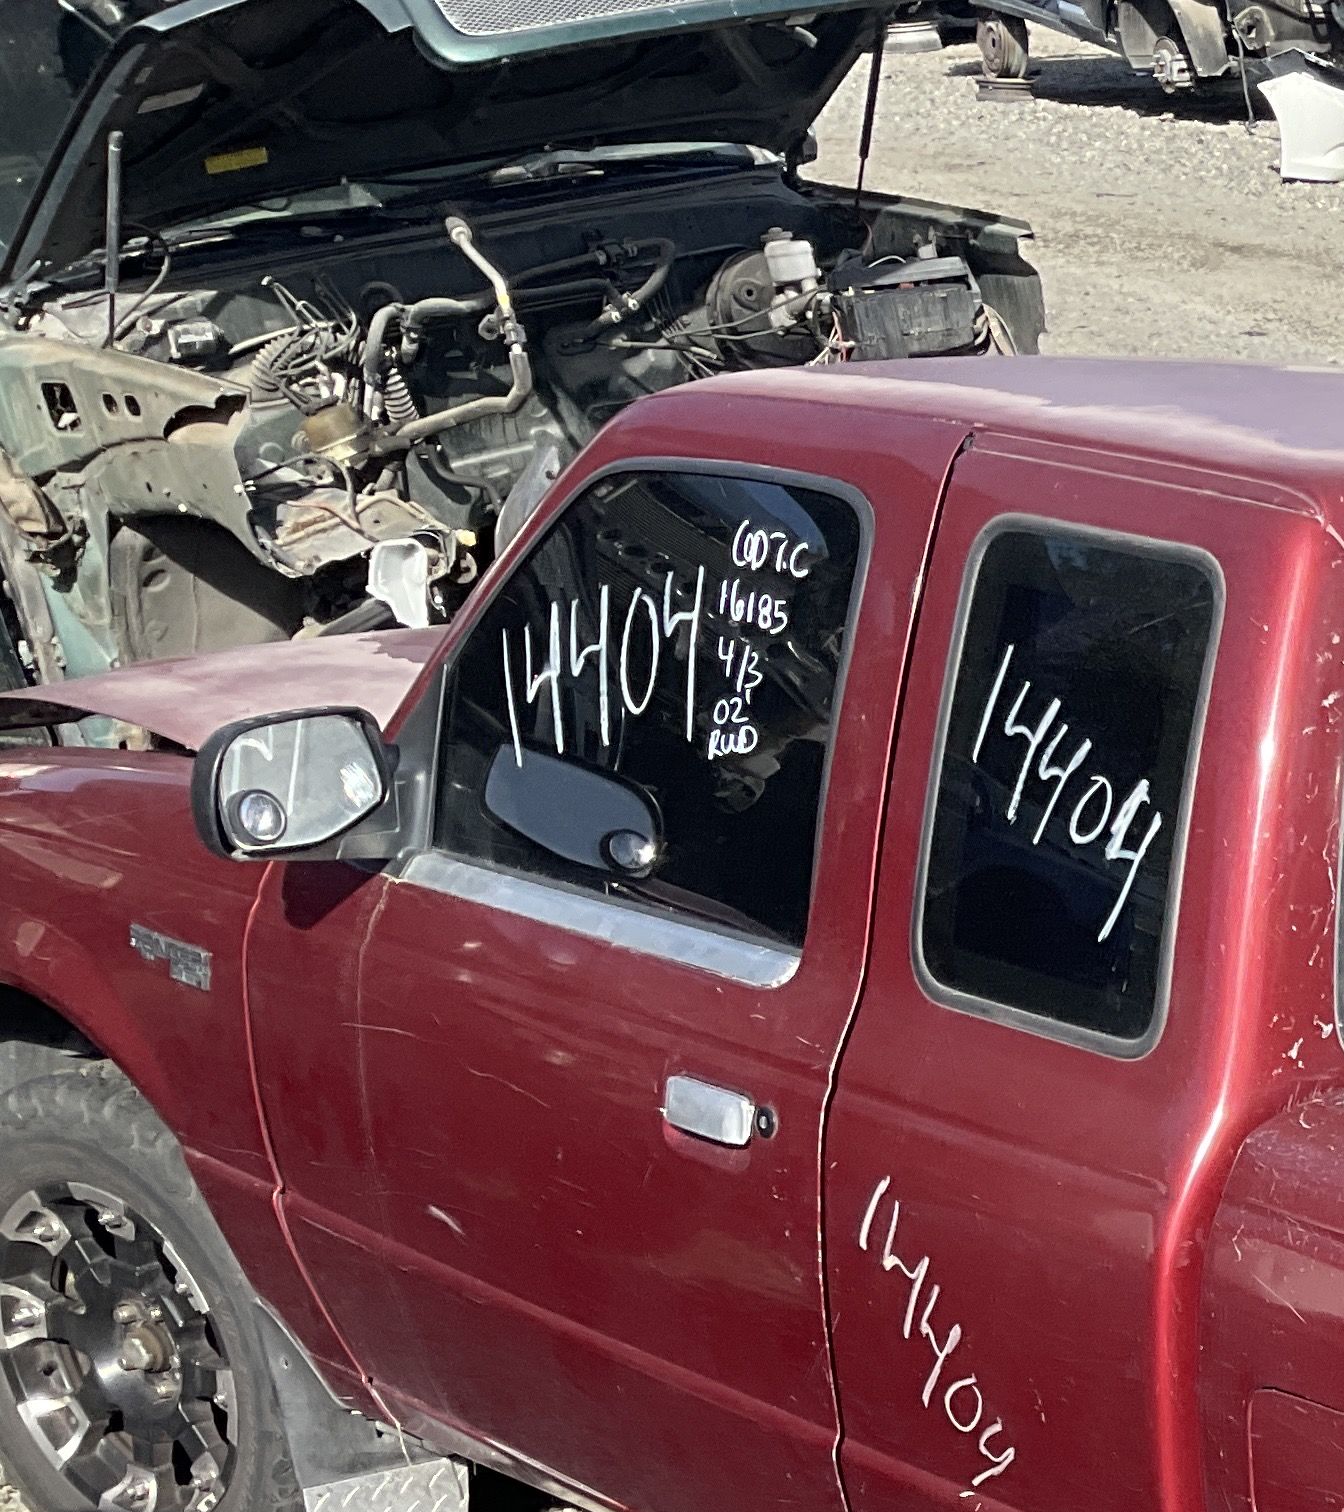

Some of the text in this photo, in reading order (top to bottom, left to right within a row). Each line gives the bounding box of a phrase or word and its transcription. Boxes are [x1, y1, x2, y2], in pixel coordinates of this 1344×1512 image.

[502, 565, 704, 767] 14404
[719, 578, 788, 635] 16185
[972, 644, 1162, 942] 14404
[859, 1176, 1015, 1498] 14404
